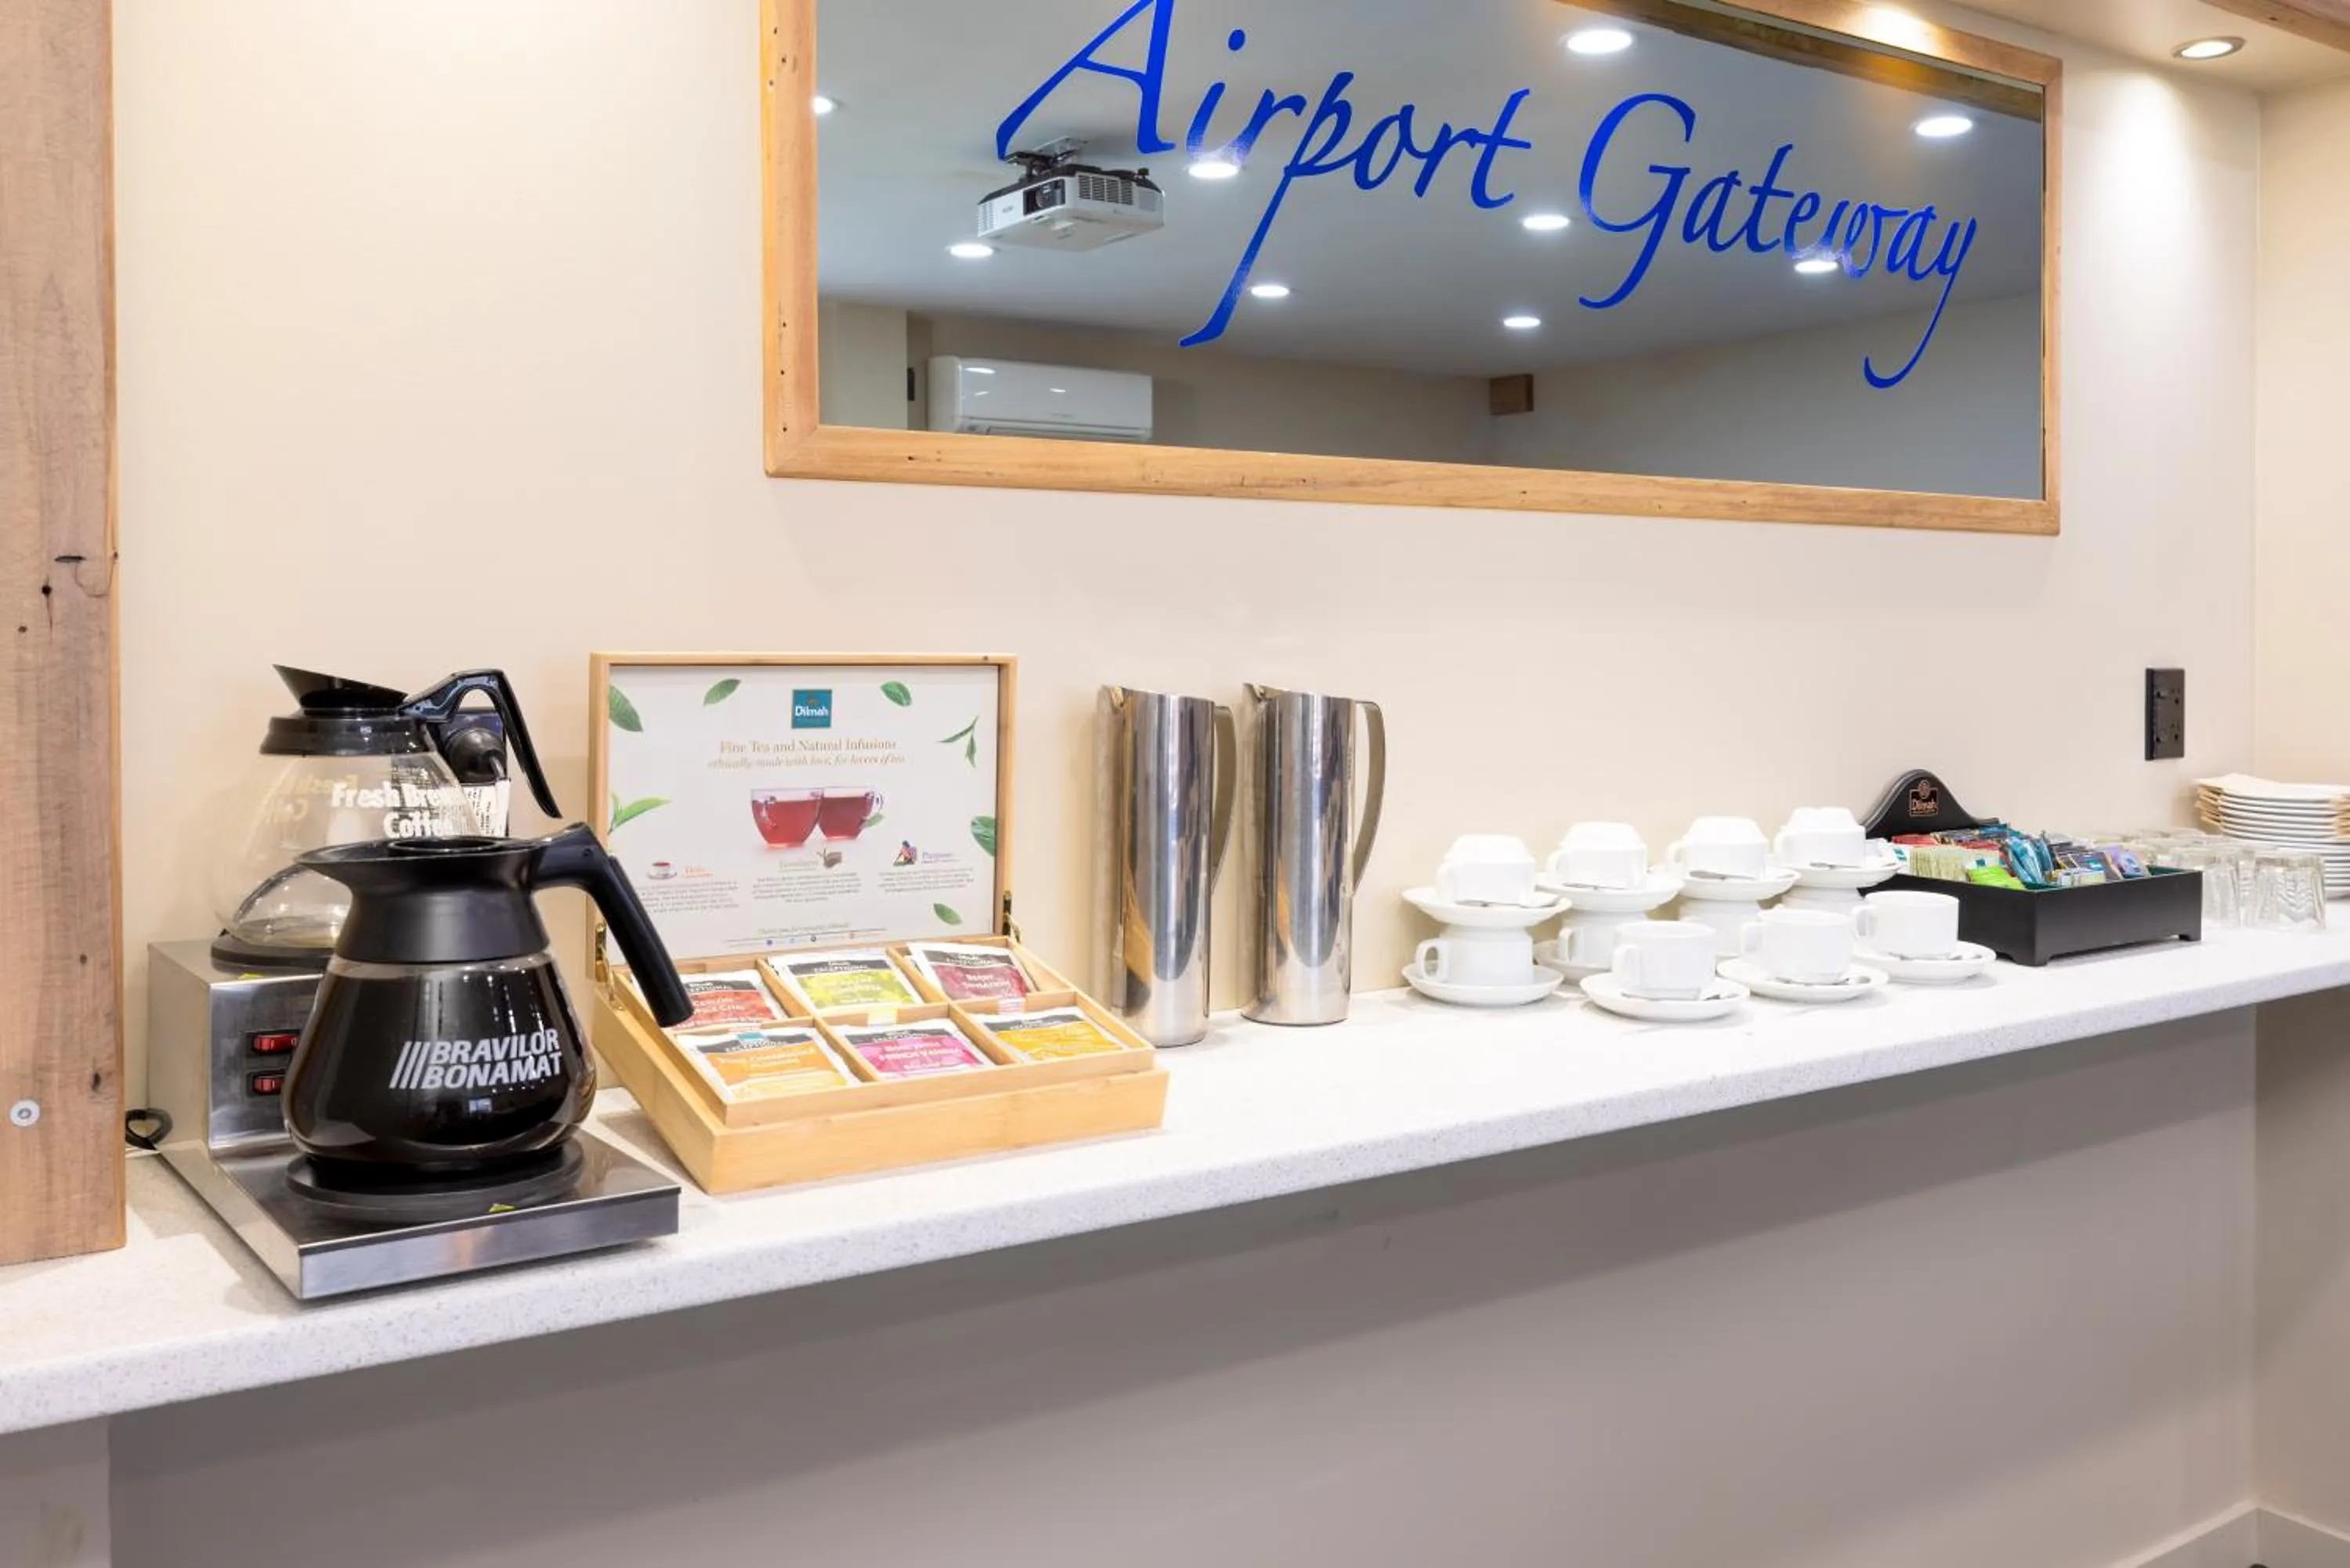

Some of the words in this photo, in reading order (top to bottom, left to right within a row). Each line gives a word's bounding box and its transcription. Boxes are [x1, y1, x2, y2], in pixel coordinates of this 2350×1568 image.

[997, 0, 1531, 347] Airport
[1578, 92, 1977, 389] Gateway
[795, 705, 829, 717] Dilmah
[720, 740, 745, 753] Fine
[750, 740, 770, 753] Tea
[773, 739, 796, 753] and
[799, 739, 842, 752] Natural
[846, 738, 897, 751] Infusions
[330, 781, 400, 808] Fresh
[428, 1028, 560, 1064] BRAVILOR
[420, 1052, 562, 1089] BONAMAT
